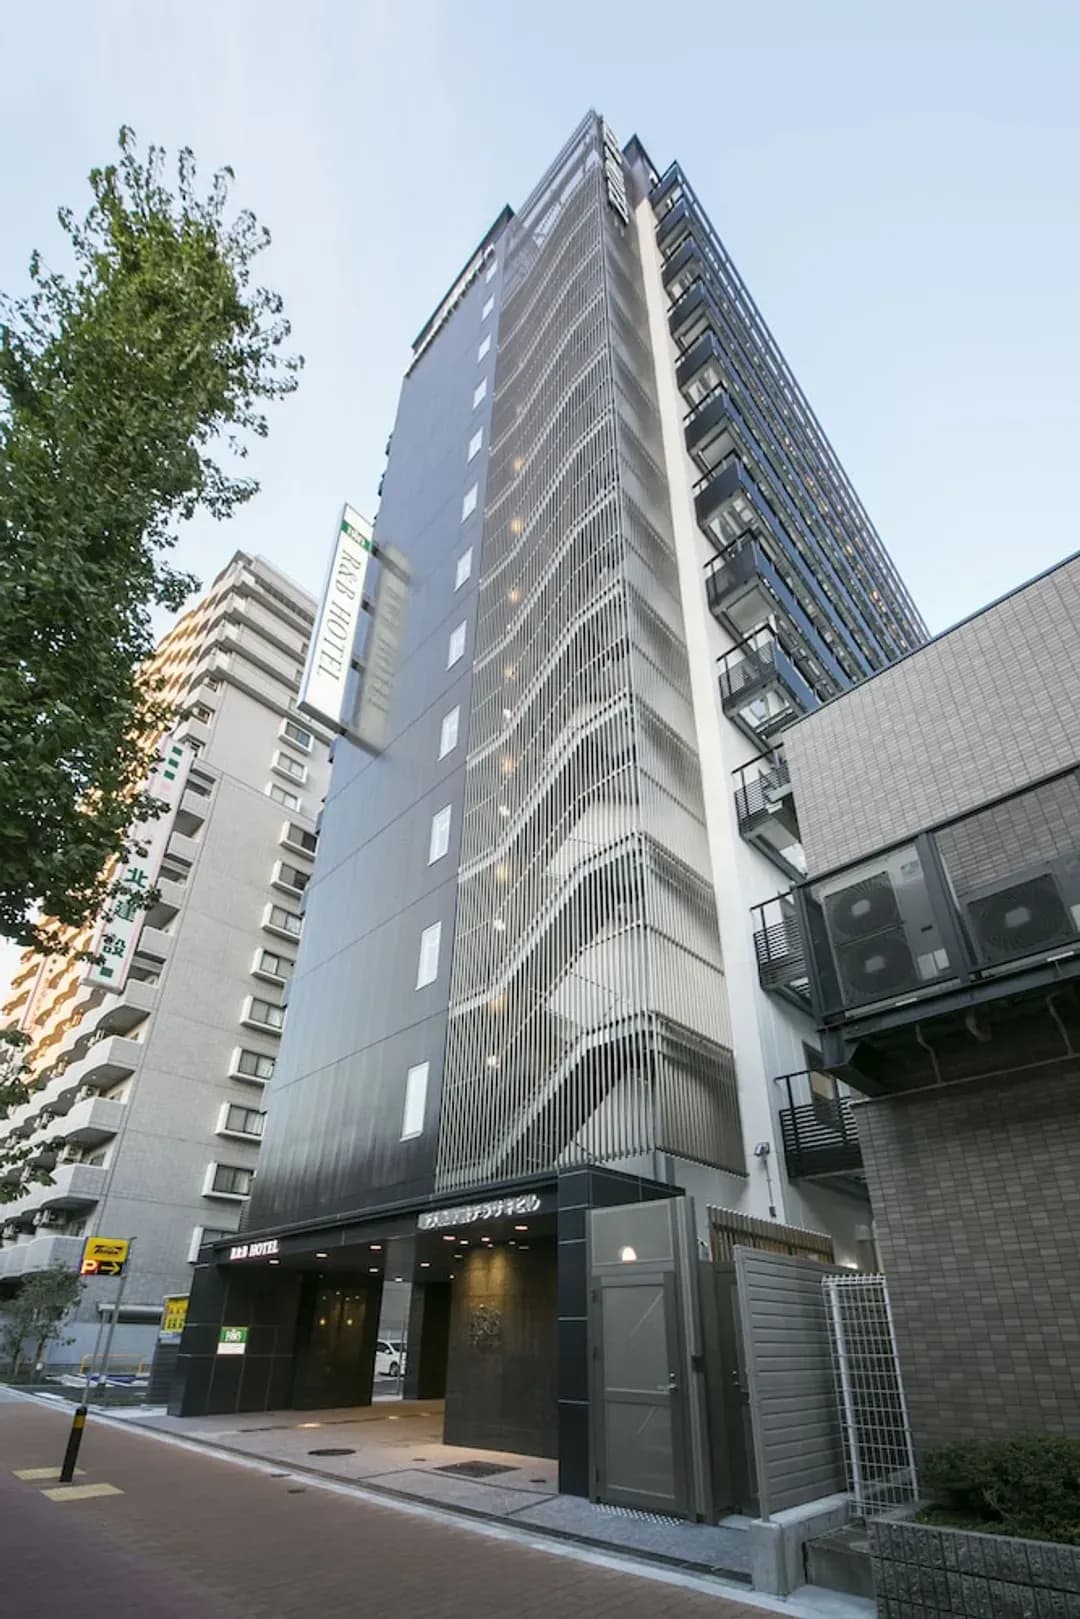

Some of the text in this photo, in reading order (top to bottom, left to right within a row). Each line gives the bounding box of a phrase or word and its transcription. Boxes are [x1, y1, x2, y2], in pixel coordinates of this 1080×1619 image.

[335, 549, 361, 600] R&B
[316, 601, 351, 680] HOTEL
[249, 1239, 279, 1257] HOTEL
